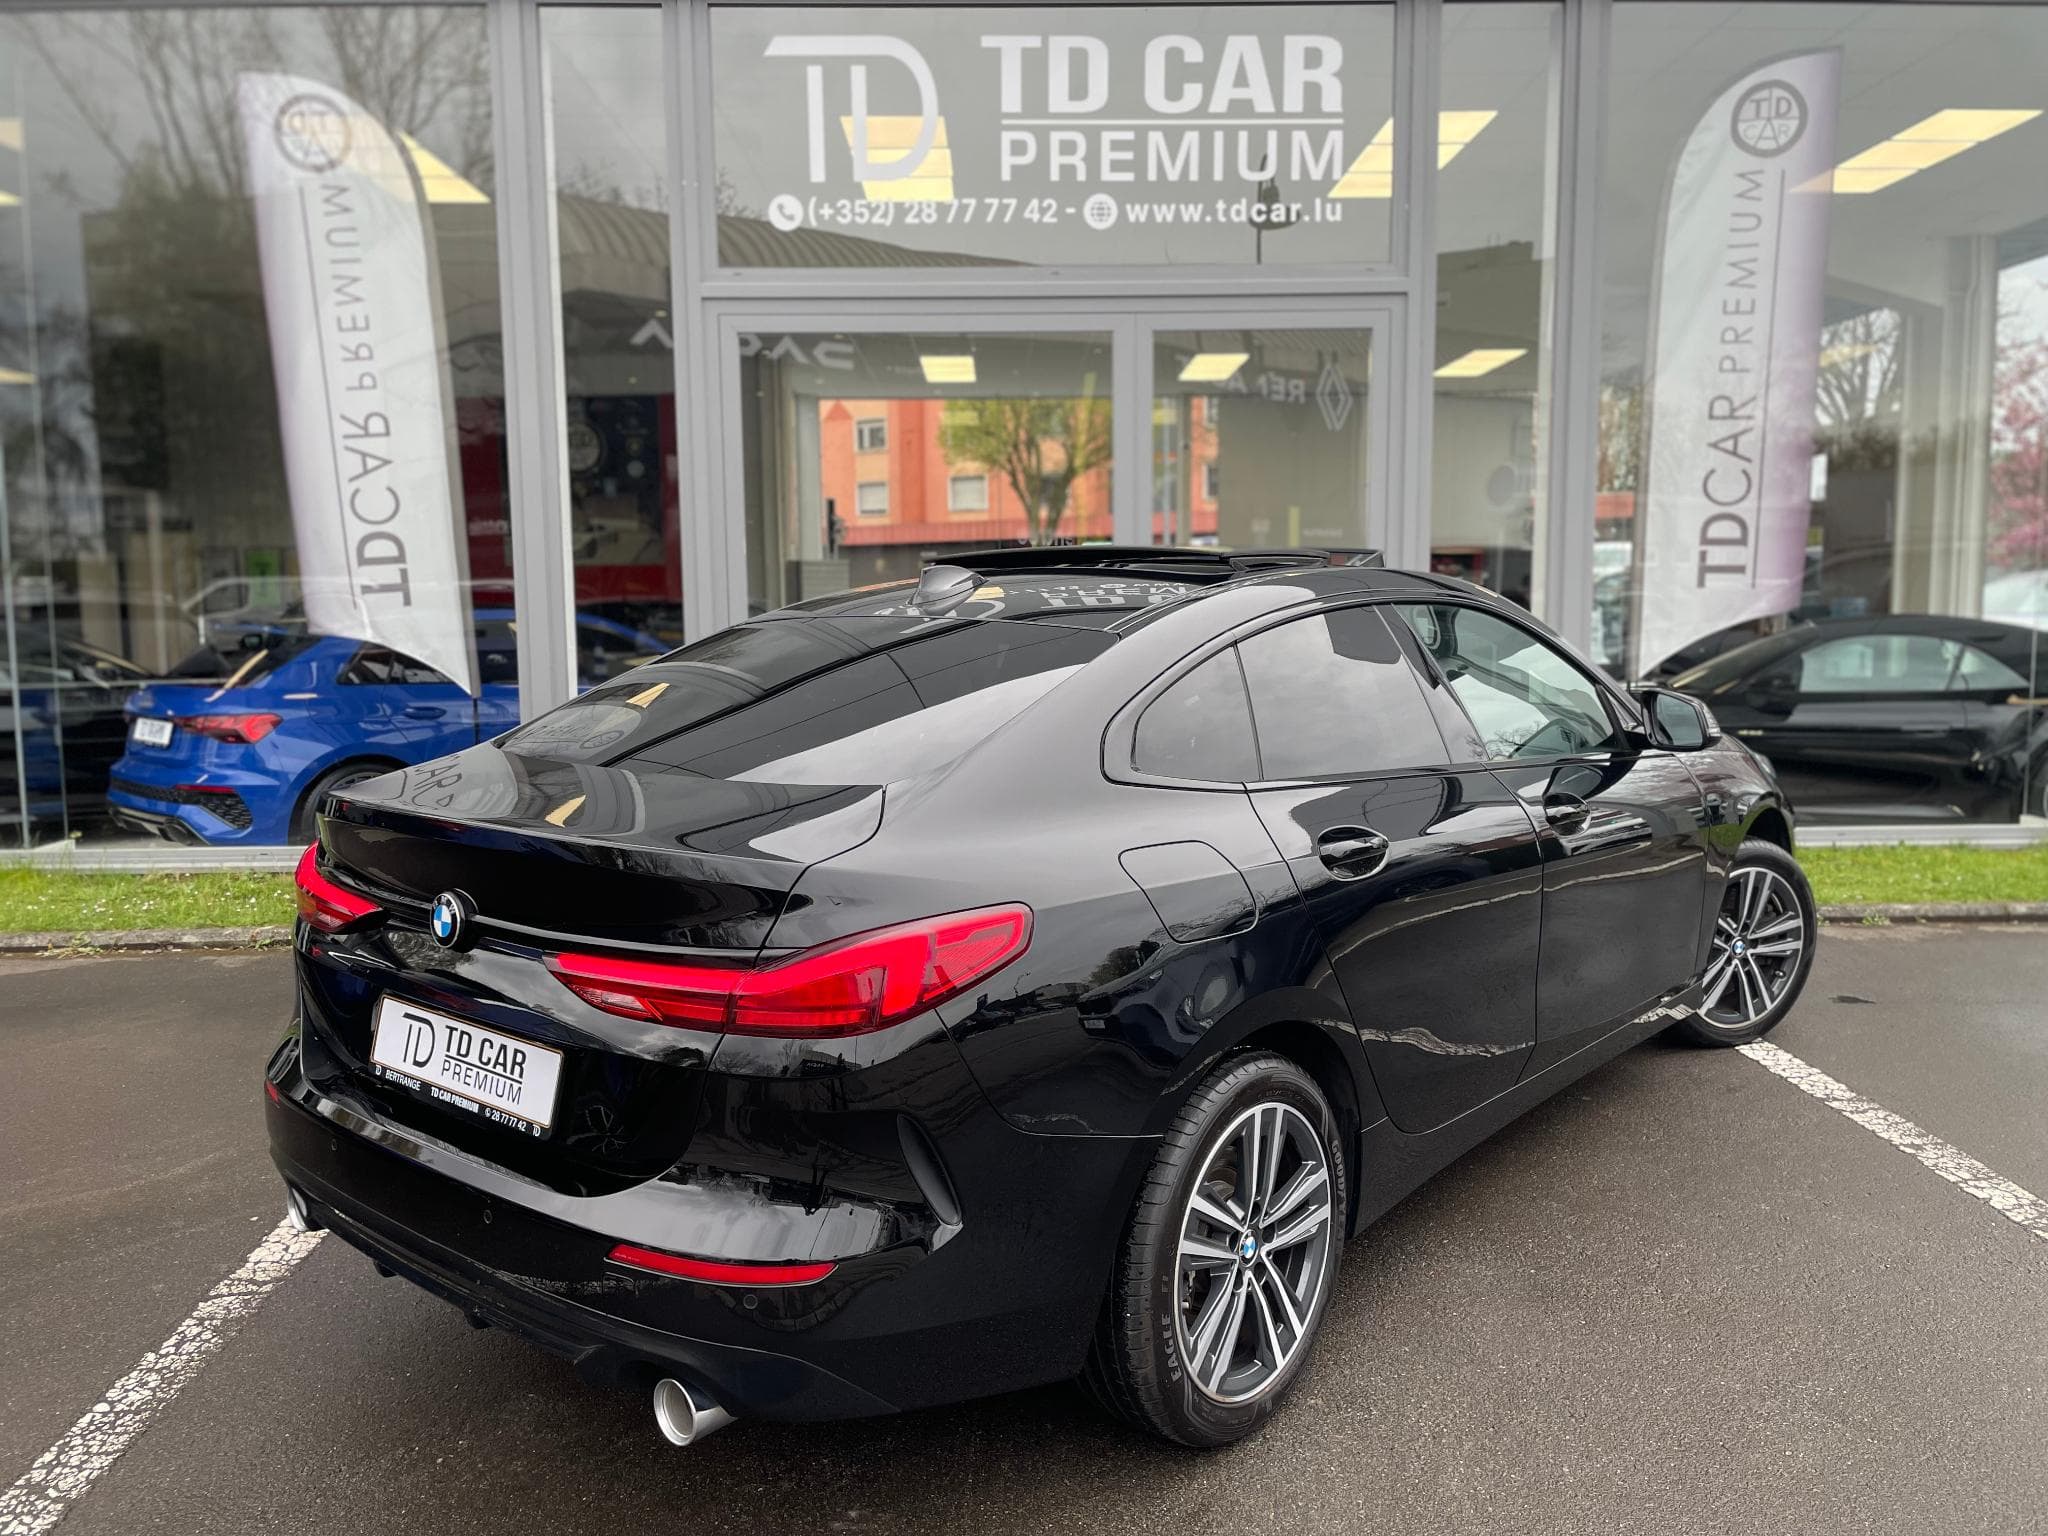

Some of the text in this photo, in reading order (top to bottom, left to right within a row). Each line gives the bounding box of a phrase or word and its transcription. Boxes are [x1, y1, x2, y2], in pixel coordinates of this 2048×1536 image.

[980, 35, 1344, 114] TD CAR
[1001, 130, 1345, 182] PREMIUM
[808, 196, 895, 227] (+352)
[904, 199, 938, 224] 28
[946, 198, 977, 223] 77
[984, 198, 1018, 223] 77
[1023, 198, 1058, 223] 42
[1125, 198, 1344, 223] www.tdcar.lu
[1697, 169, 1765, 588] TDCAR PREMIUM
[445, 1025, 527, 1079] TD CAR
[385, 1069, 421, 1091] BERTRANGE
[430, 1086, 440, 1098] TD
[441, 1059, 522, 1105] PREMIUM
[491, 1109, 500, 1122] 28
[517, 1120, 527, 1132] 42
[1161, 1313, 1182, 1382] EAGLE
